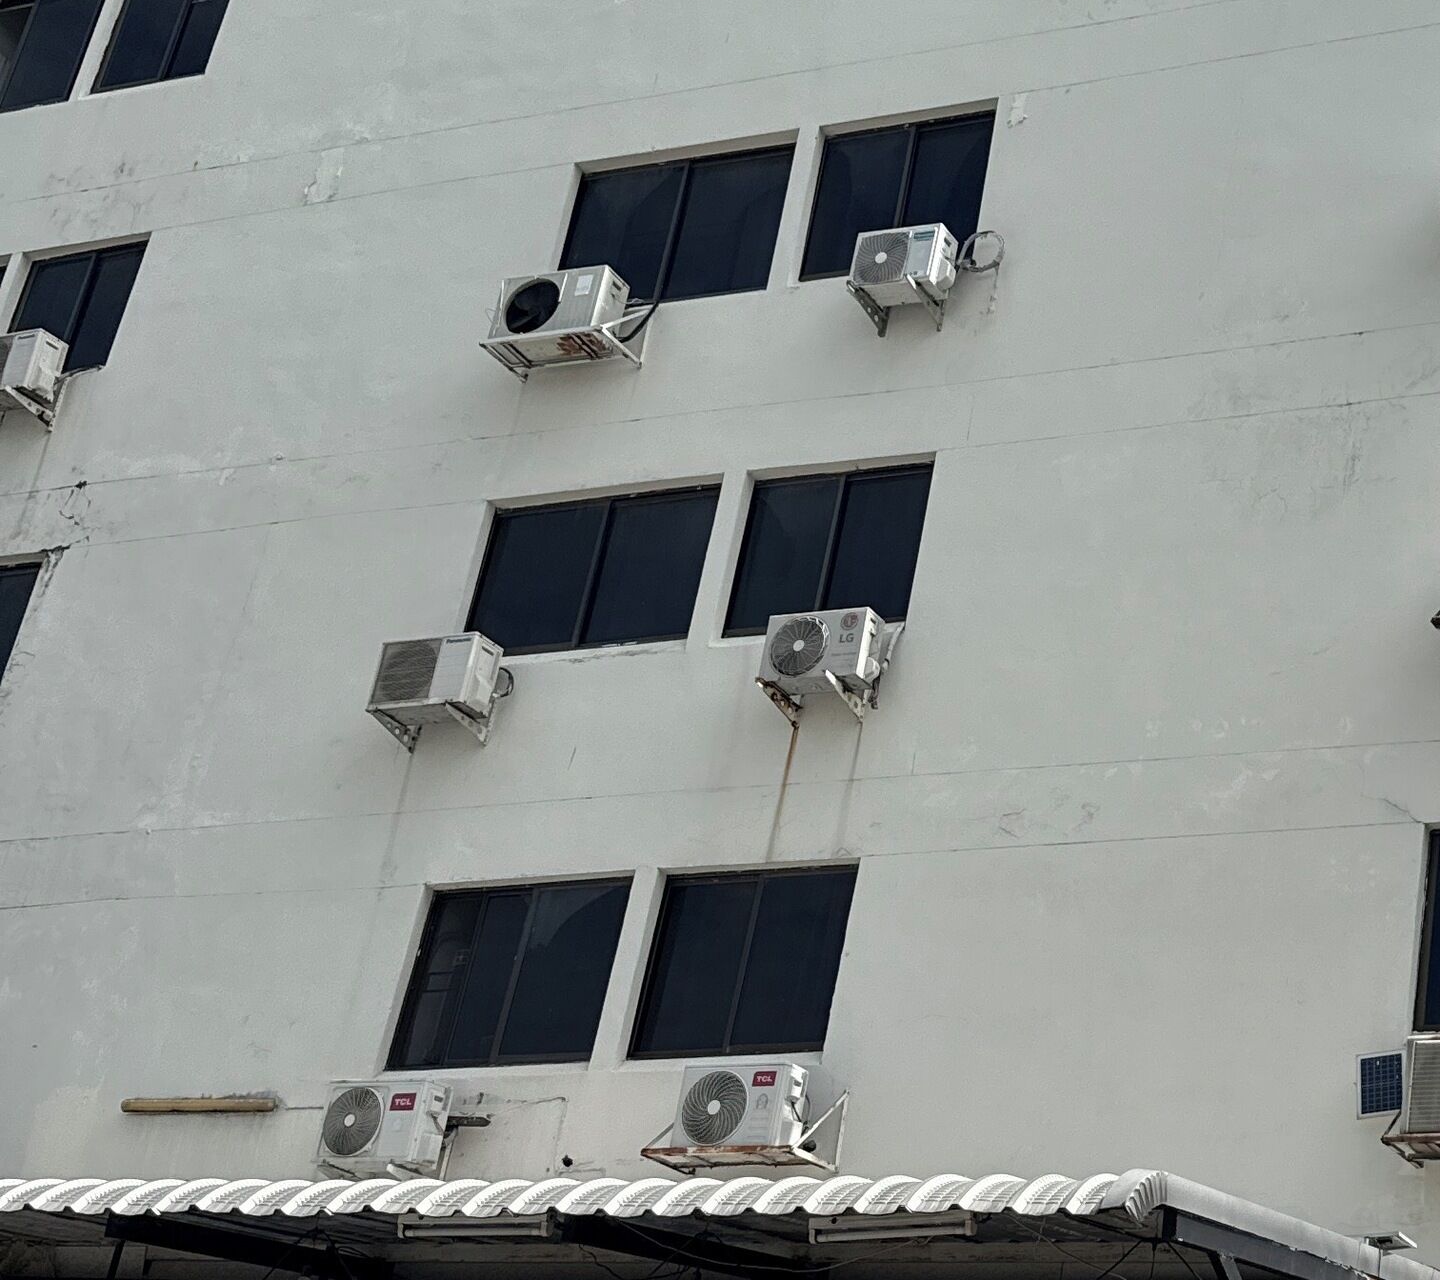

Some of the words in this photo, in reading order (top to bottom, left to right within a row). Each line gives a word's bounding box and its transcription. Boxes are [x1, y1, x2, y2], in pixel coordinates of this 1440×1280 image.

[838, 633, 854, 644] LG
[757, 1075, 773, 1083] TCL
[394, 1098, 412, 1106] TCL
